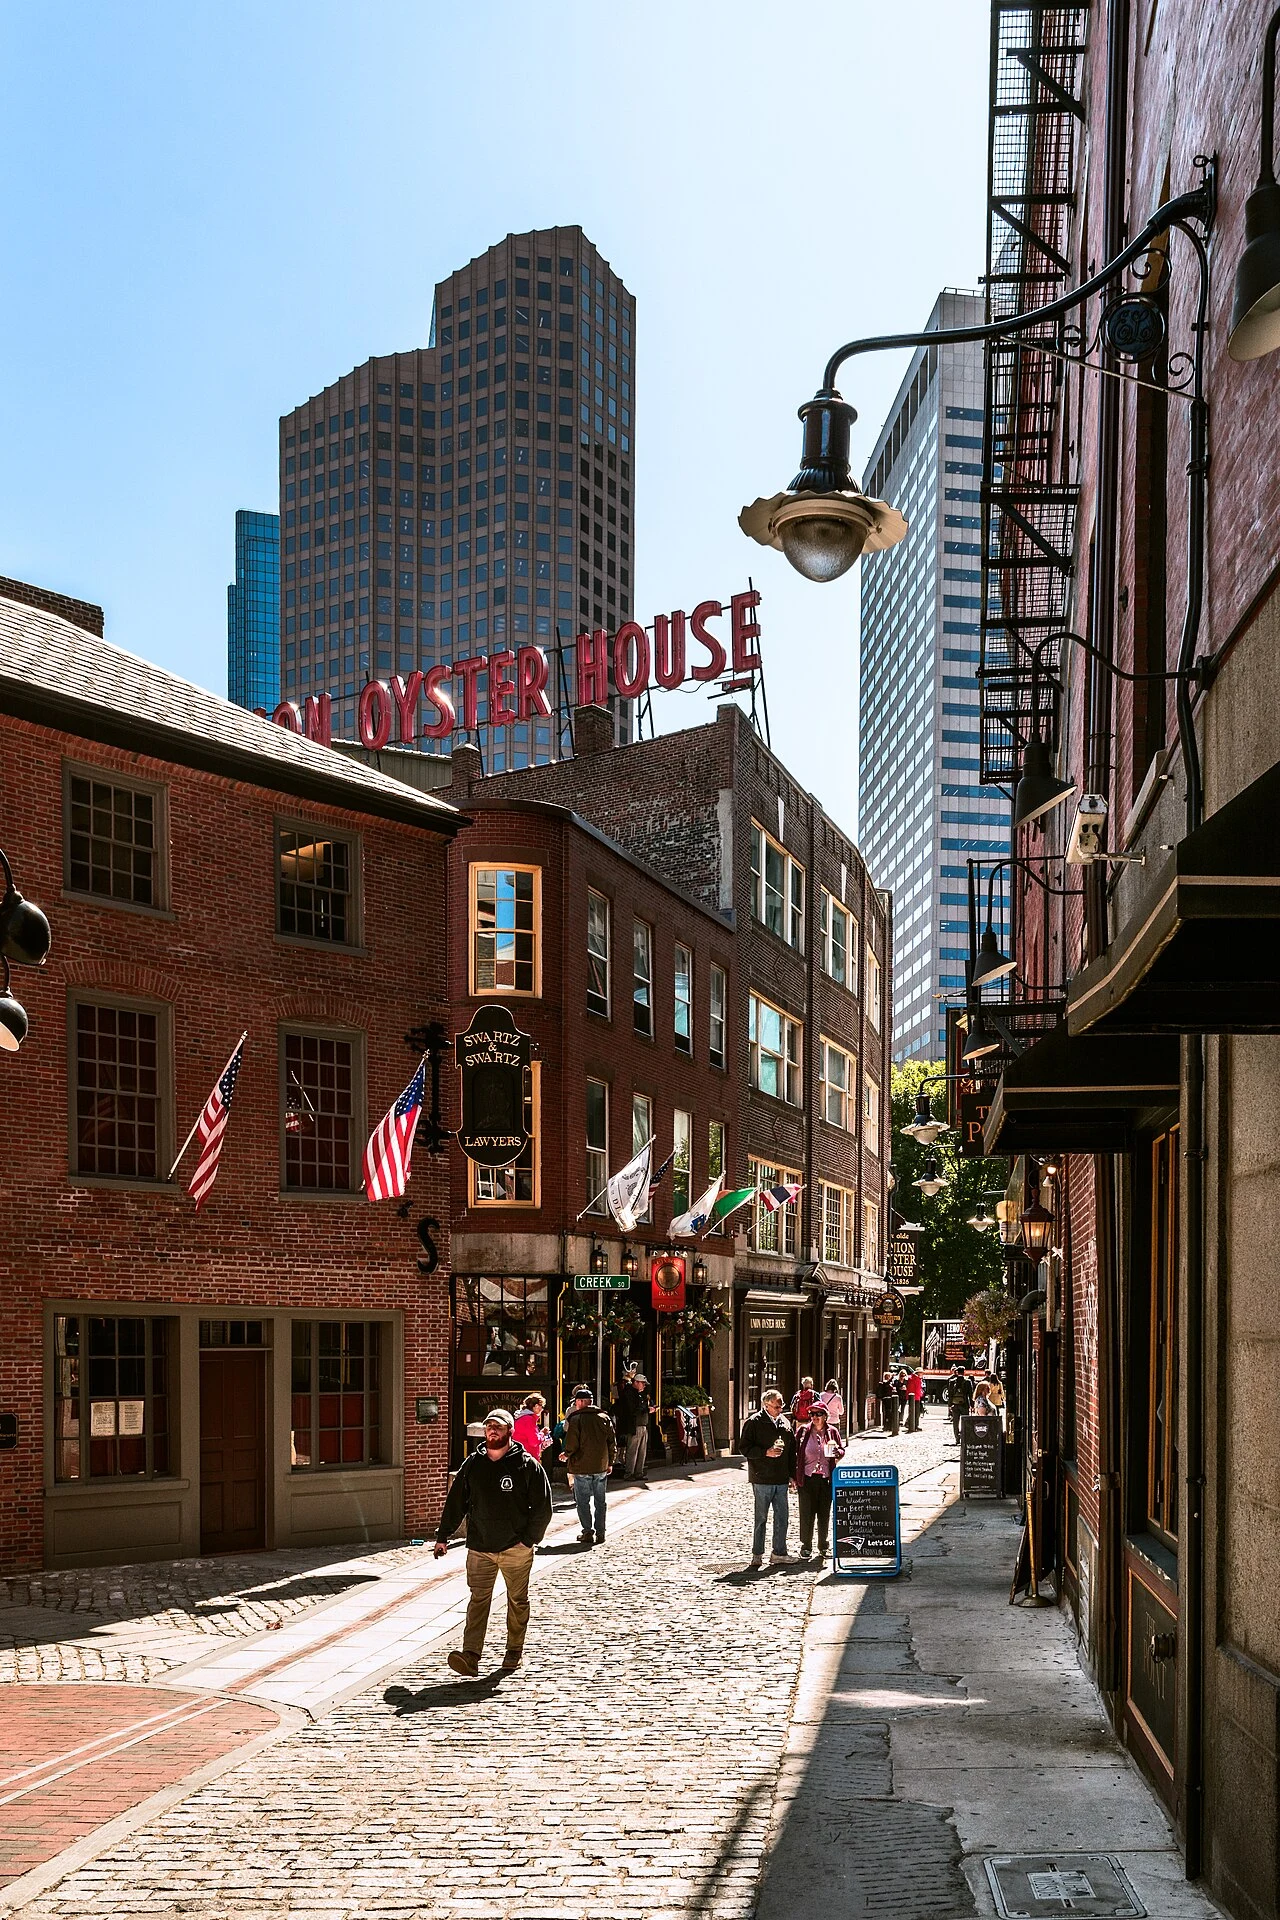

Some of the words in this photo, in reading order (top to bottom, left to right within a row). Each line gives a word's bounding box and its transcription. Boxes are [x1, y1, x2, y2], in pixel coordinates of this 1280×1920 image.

[359, 645, 553, 751] OYSTER
[576, 590, 762, 706] HOUSE
[463, 1031, 521, 1048] SWARTZ
[488, 1042, 497, 1052] &
[465, 1051, 521, 1067] SWARTZ
[464, 1136, 522, 1147] LAWYERS
[889, 1265, 914, 1277] OUSE
[579, 1276, 612, 1288] CREEK
[478, 1393, 499, 1405] GREEN
[501, 1393, 523, 1404] DRAGO
[840, 1471, 861, 1479] BUD
[862, 1470, 890, 1478] LIGHT
[836, 1489, 847, 1497] In
[837, 1505, 848, 1513] In
[849, 1504, 865, 1512] Beer
